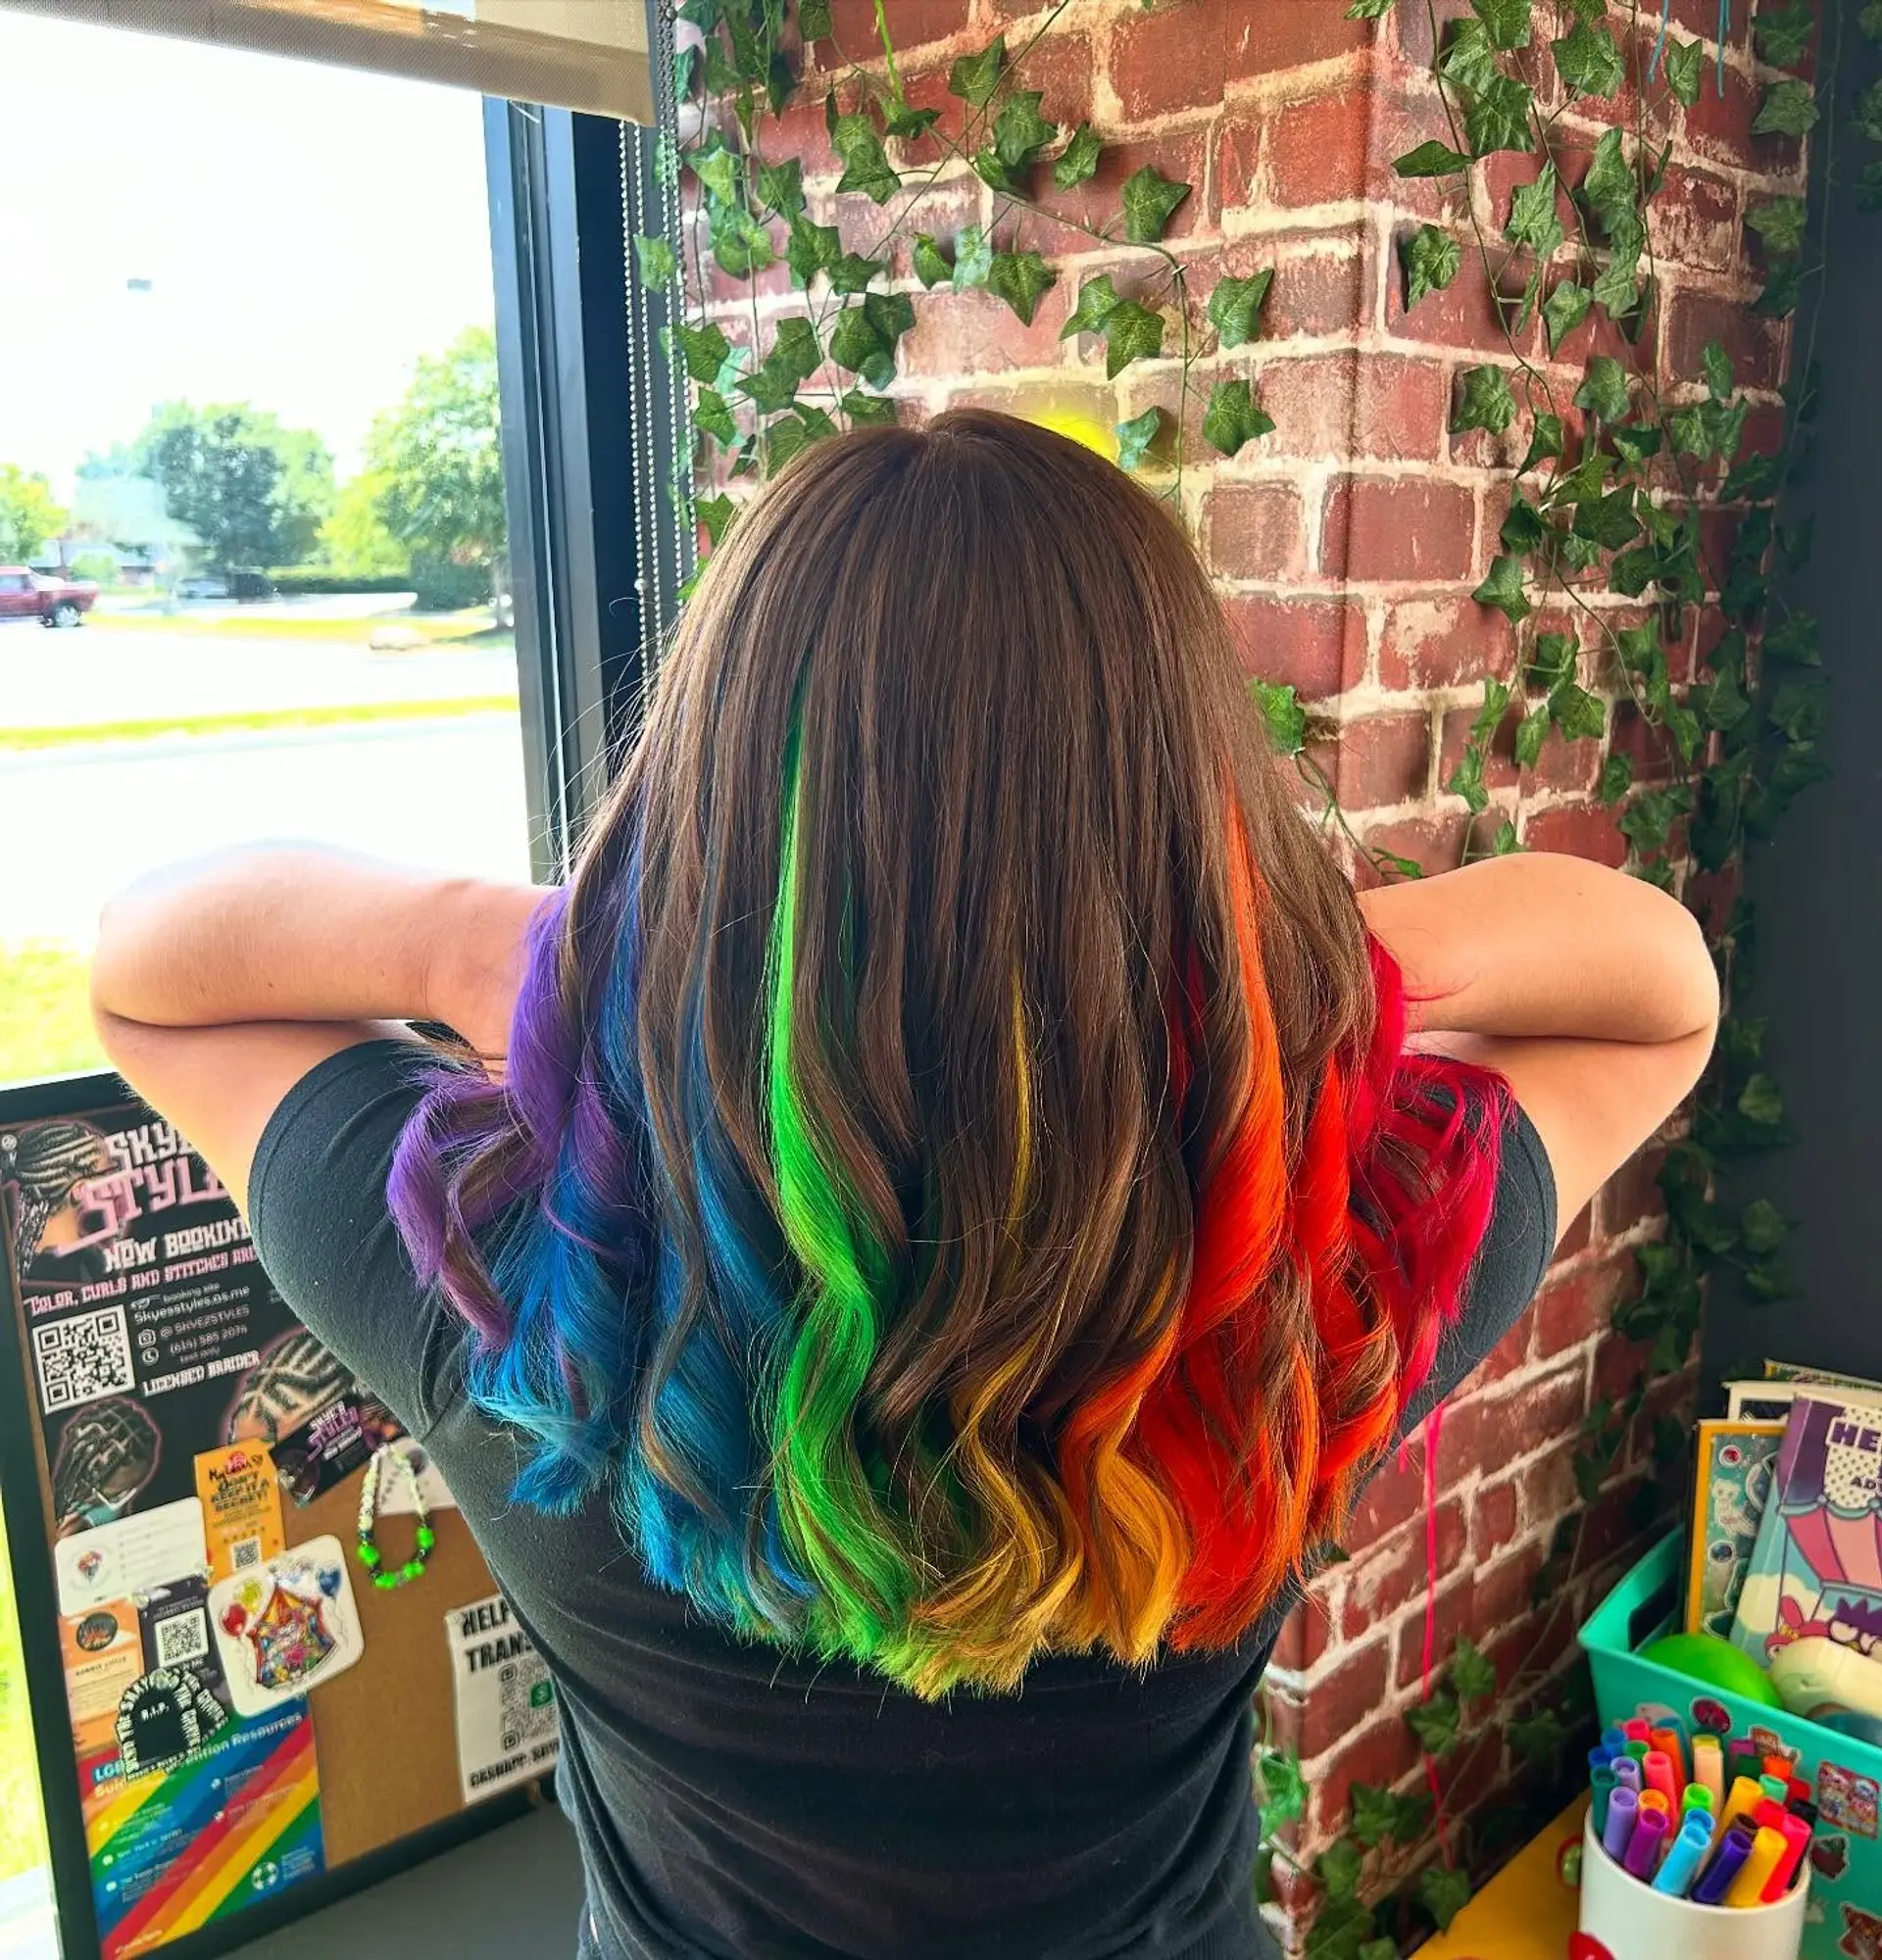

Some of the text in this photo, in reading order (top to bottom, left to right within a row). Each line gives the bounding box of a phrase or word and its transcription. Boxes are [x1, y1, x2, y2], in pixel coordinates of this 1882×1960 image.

[81, 1277, 126, 1304] CURLS
[131, 1269, 160, 1292] AND
[165, 1251, 229, 1283] STITCHES
[105, 1237, 157, 1273] NOW
[143, 1349, 261, 1398] LICENSED BRAIDER
